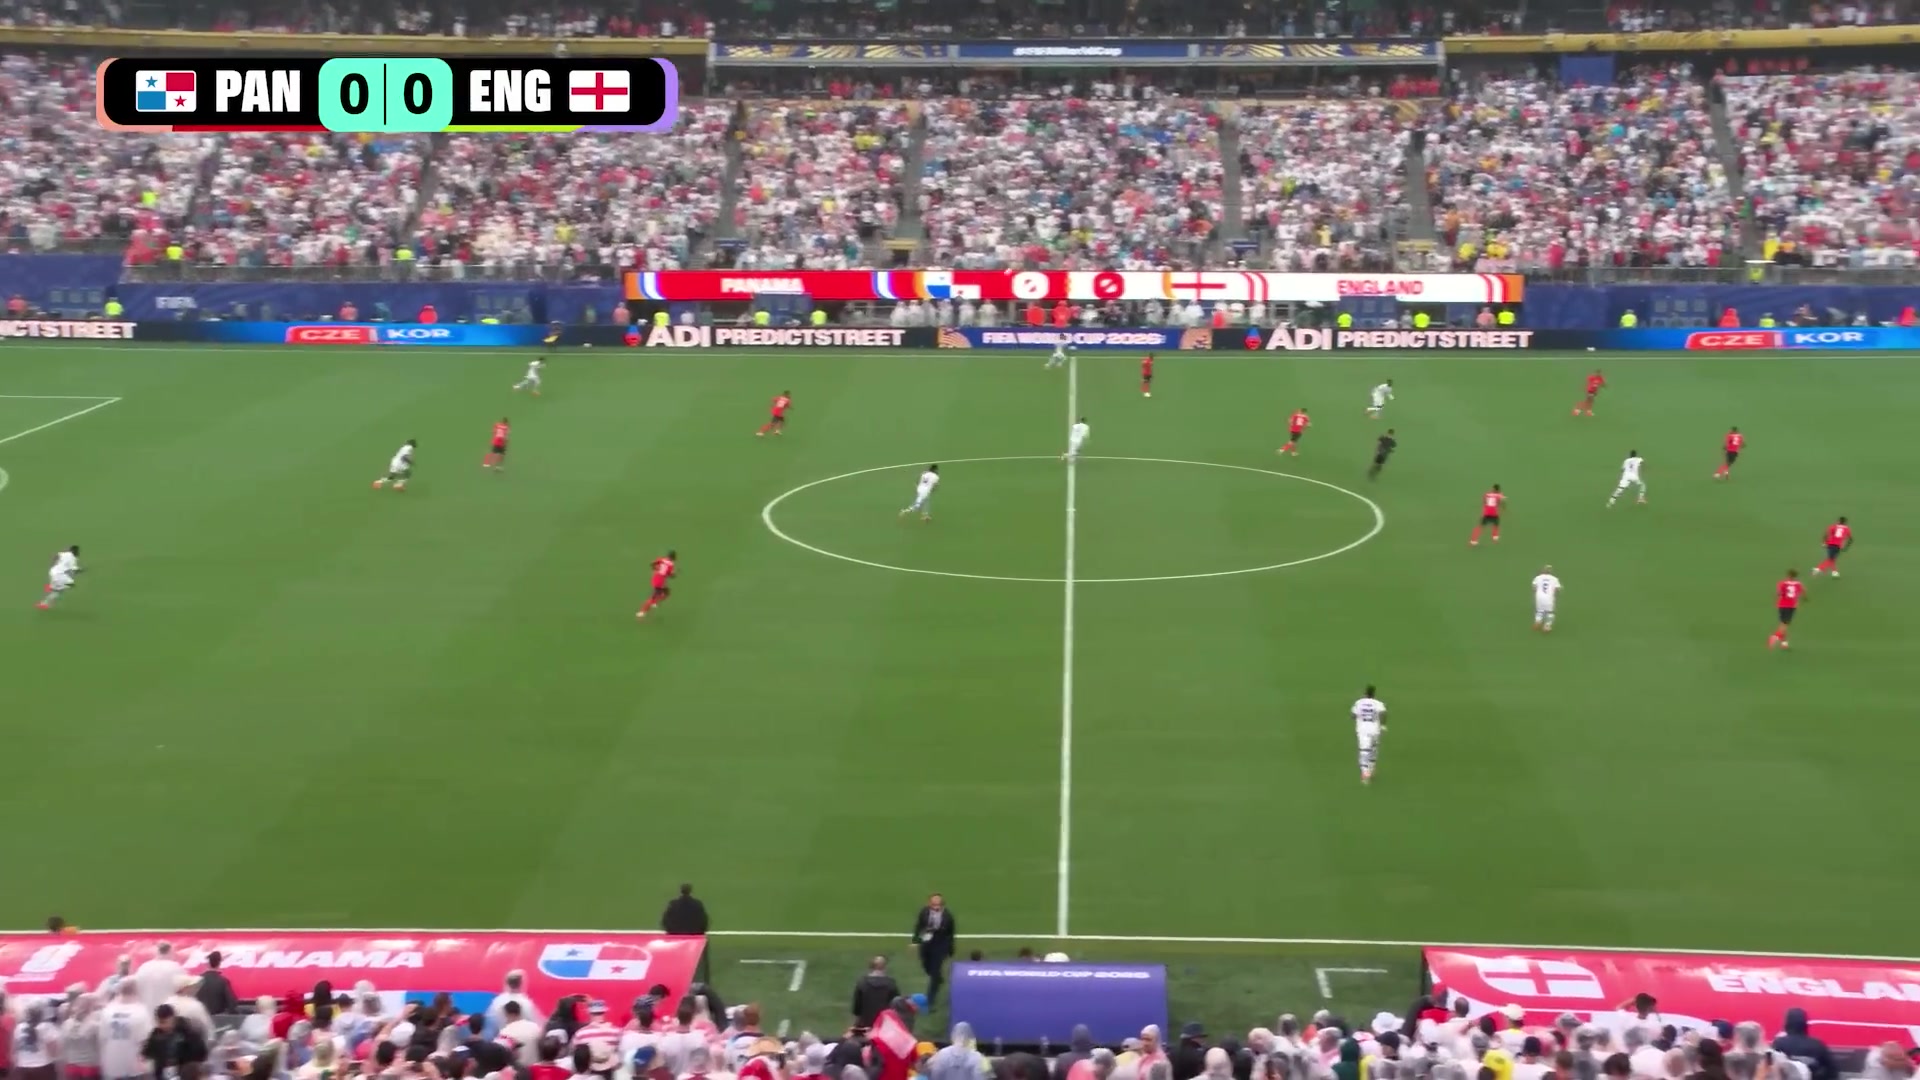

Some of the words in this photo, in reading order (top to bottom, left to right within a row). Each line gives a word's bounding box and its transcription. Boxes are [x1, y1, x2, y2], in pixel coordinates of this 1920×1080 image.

[721, 278, 804, 293] PANAMA
[1336, 280, 1424, 295] ENGLAND
[300, 329, 361, 340] CZE
[387, 328, 450, 339] KOR
[646, 325, 711, 347] ADI
[715, 328, 905, 346] PREDICTSTREET
[982, 332, 1015, 344] FIFA
[1074, 332, 1106, 344] CUP
[1105, 333, 1162, 345] 2026
[1265, 327, 1332, 350] ADI
[1336, 330, 1534, 348] PREDICTSTREET
[1700, 335, 1765, 346] CZE
[1794, 332, 1864, 343] KOR
[182, 946, 424, 969] PANAMA
[1004, 970, 1060, 978] WORLD
